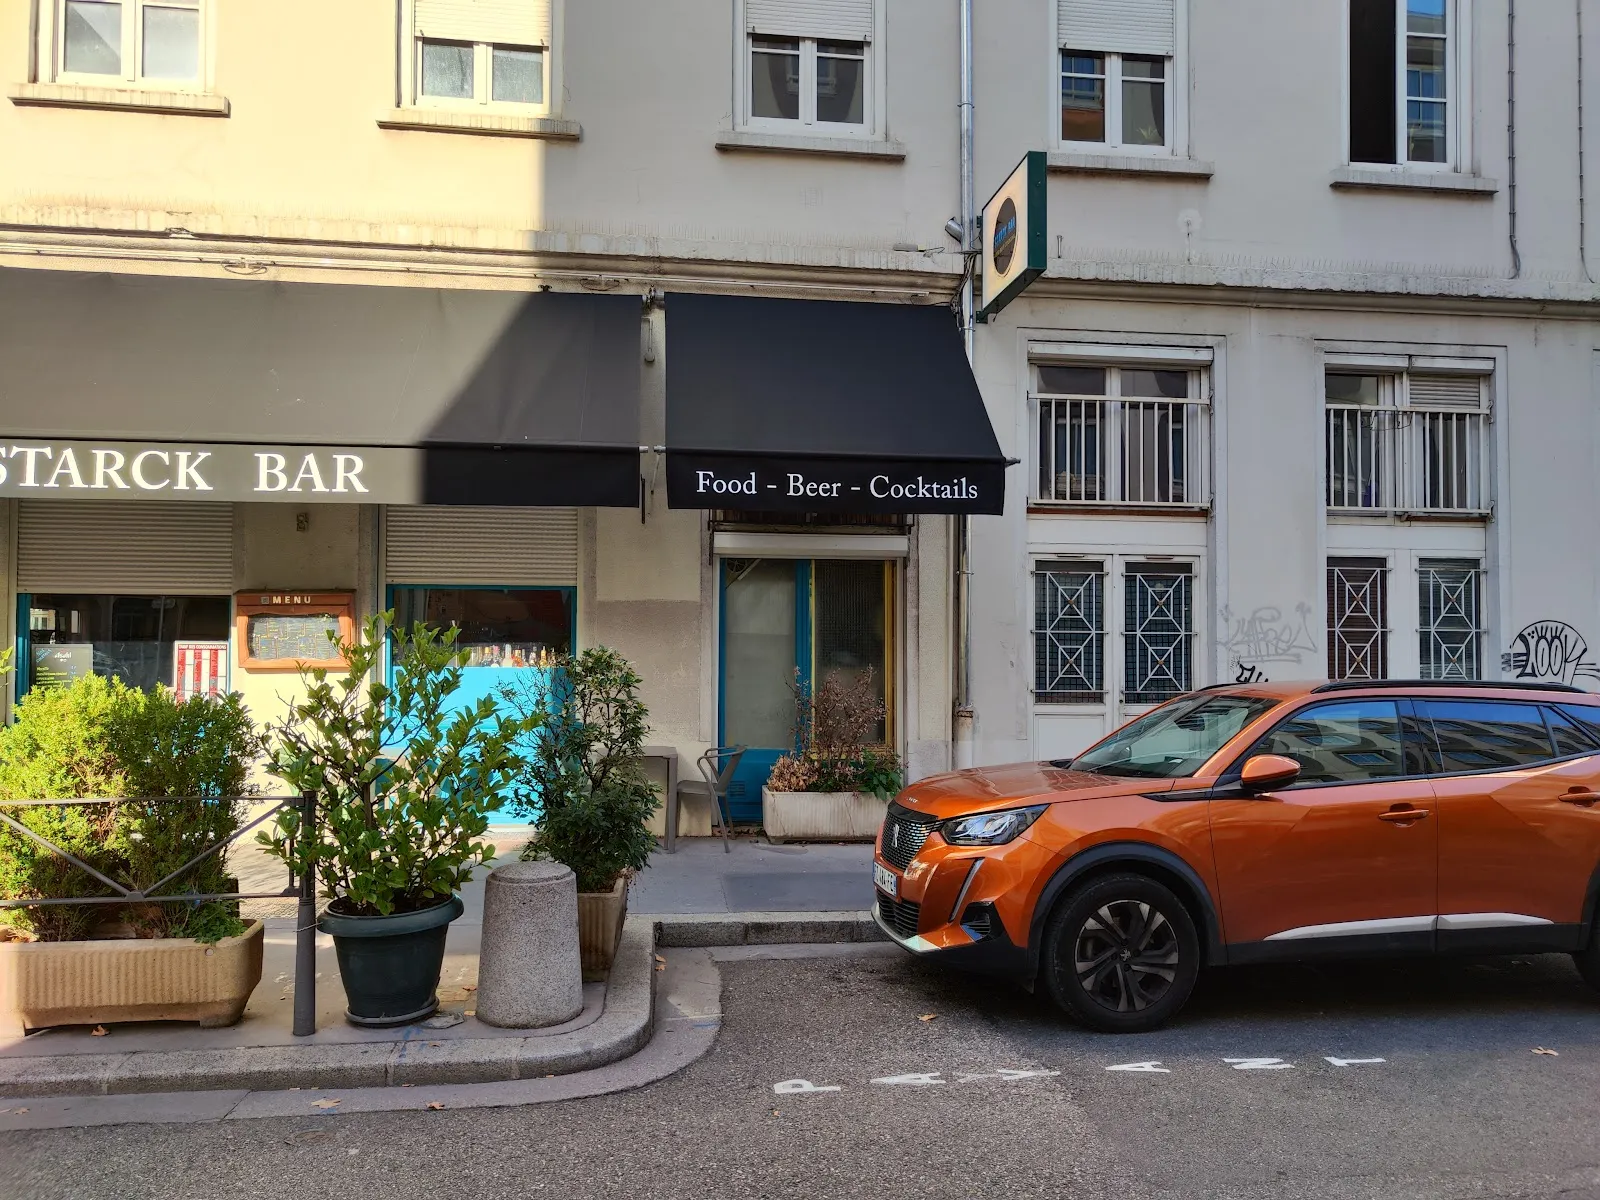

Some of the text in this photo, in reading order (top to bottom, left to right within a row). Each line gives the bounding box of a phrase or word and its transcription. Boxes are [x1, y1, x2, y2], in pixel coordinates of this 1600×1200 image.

[253, 453, 370, 493] BAR
[695, 470, 758, 496] Food
[786, 473, 842, 498] Beer
[869, 475, 978, 500] Cocktails
[272, 596, 311, 604] MENU
